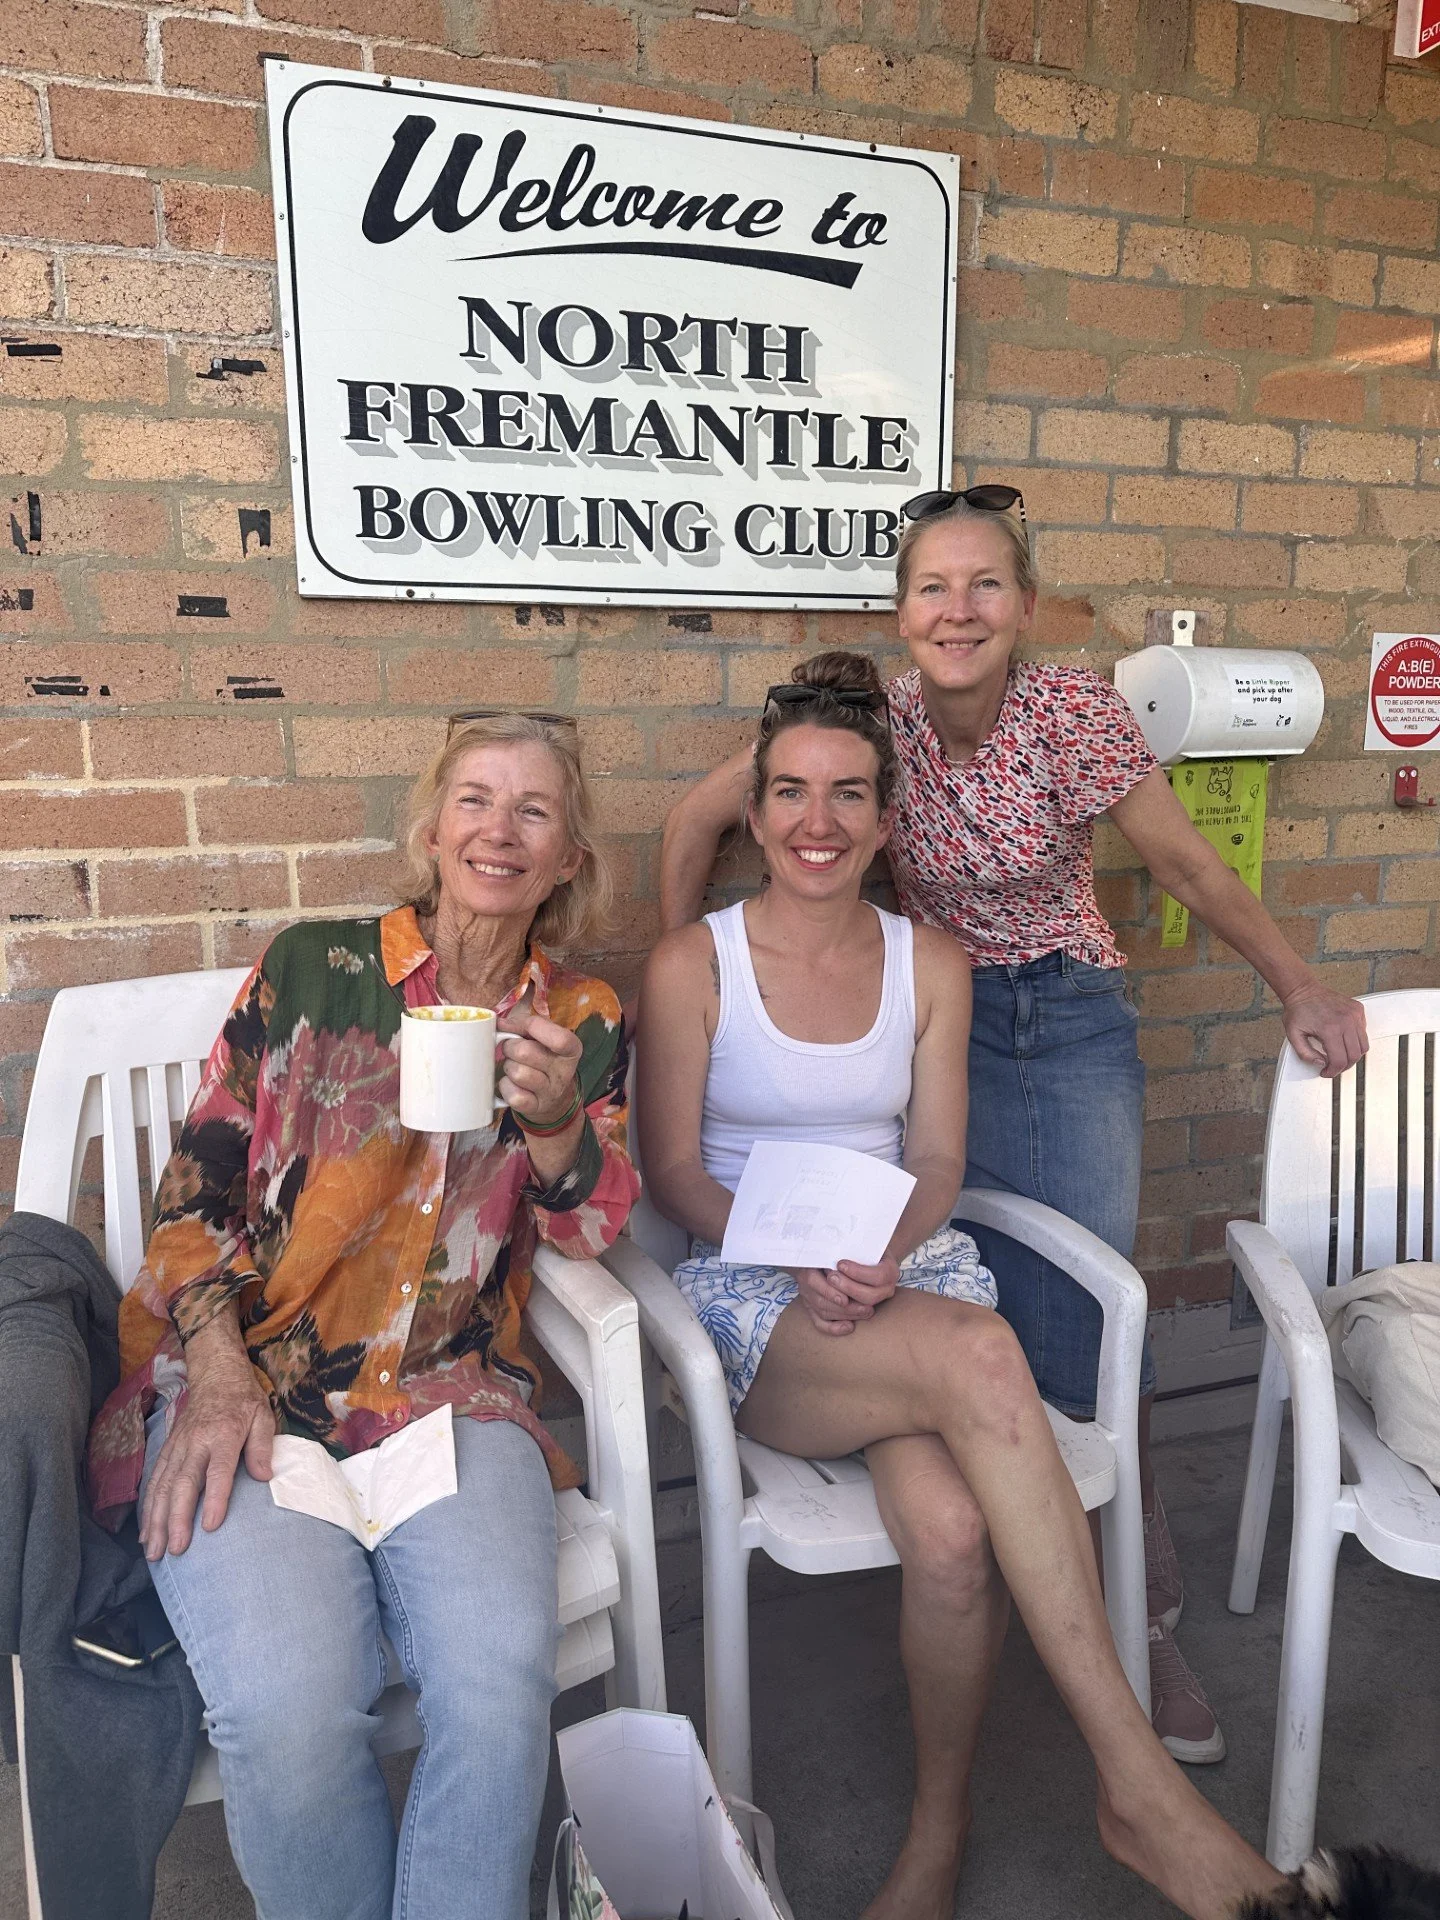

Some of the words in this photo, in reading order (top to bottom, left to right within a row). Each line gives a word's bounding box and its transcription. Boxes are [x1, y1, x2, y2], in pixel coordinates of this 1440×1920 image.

[362, 114, 783, 244] Welcome
[812, 192, 888, 249] to
[458, 296, 809, 384] NORTH
[337, 378, 910, 473] FREMANTLE
[354, 485, 712, 553] BOWLING
[734, 504, 899, 559] CLUB
[1378, 653, 1393, 672] THIS
[1392, 642, 1409, 657] FIRE
[1410, 640, 1440, 659] EXTINGUI
[1389, 676, 1440, 689] POWDER
[1397, 659, 1435, 674] A:B(E)
[1270, 696, 1282, 704] dog
